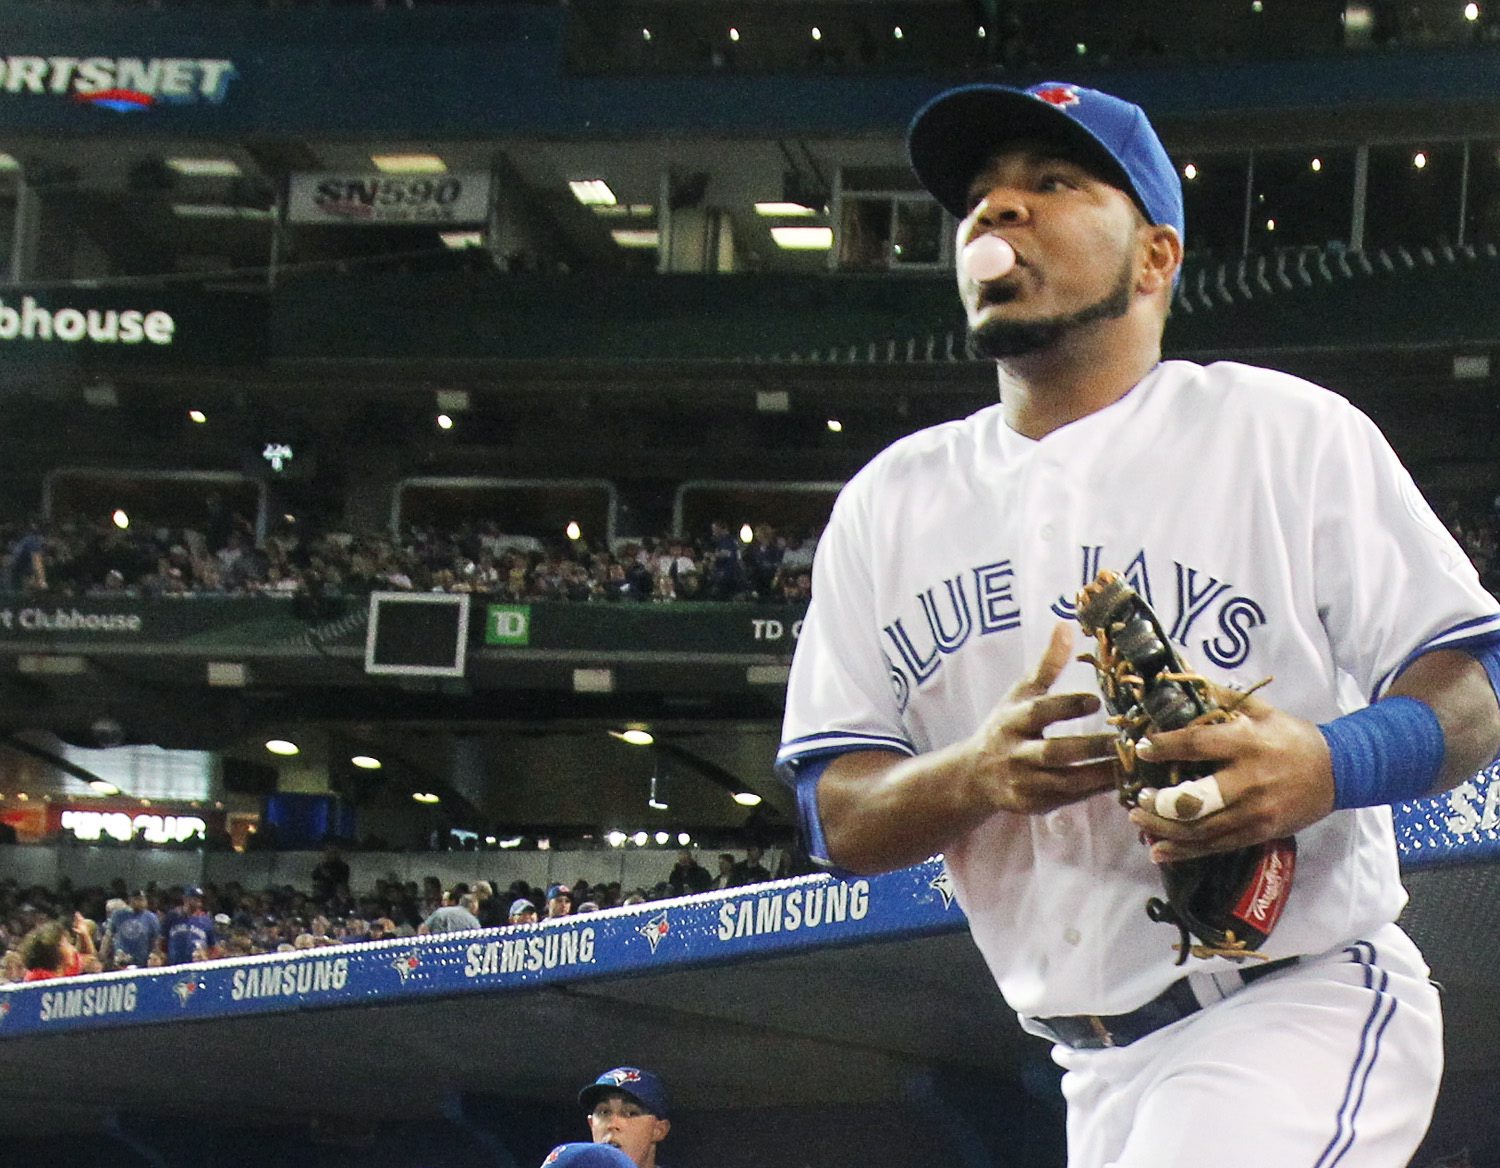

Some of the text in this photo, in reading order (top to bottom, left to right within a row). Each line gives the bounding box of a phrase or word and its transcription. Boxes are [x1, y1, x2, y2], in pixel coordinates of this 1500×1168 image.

[494, 611, 527, 636] TD
[751, 619, 784, 640] TD
[718, 880, 870, 940] SAMSUNG
[464, 928, 596, 977] SAMSUNG
[231, 959, 349, 1001] SAMSUNG
[40, 983, 137, 1022] SAMSUNG
